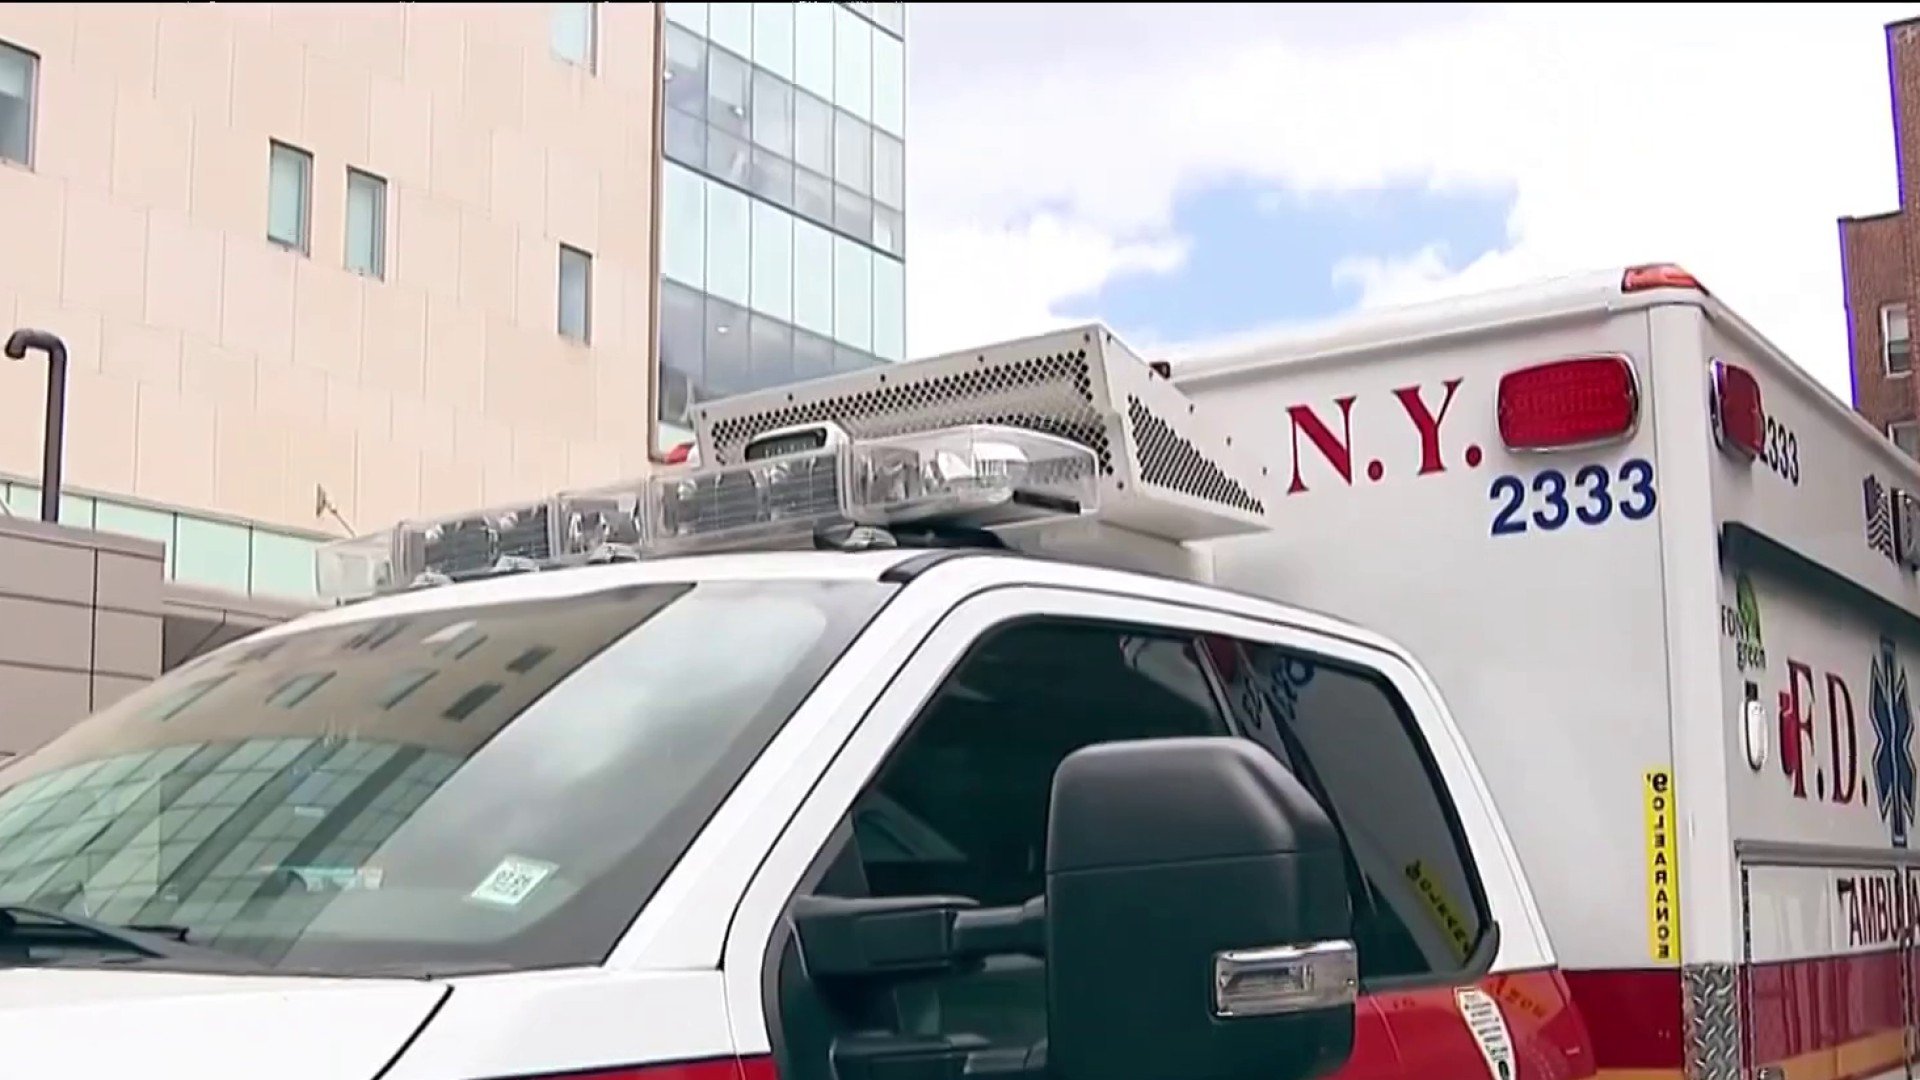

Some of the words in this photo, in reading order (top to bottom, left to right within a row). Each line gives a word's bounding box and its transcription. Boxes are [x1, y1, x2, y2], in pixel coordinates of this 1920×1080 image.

[1286, 377, 1483, 495] N.Y.
[1760, 416, 1799, 487] 333
[1489, 459, 1657, 537] 2333
